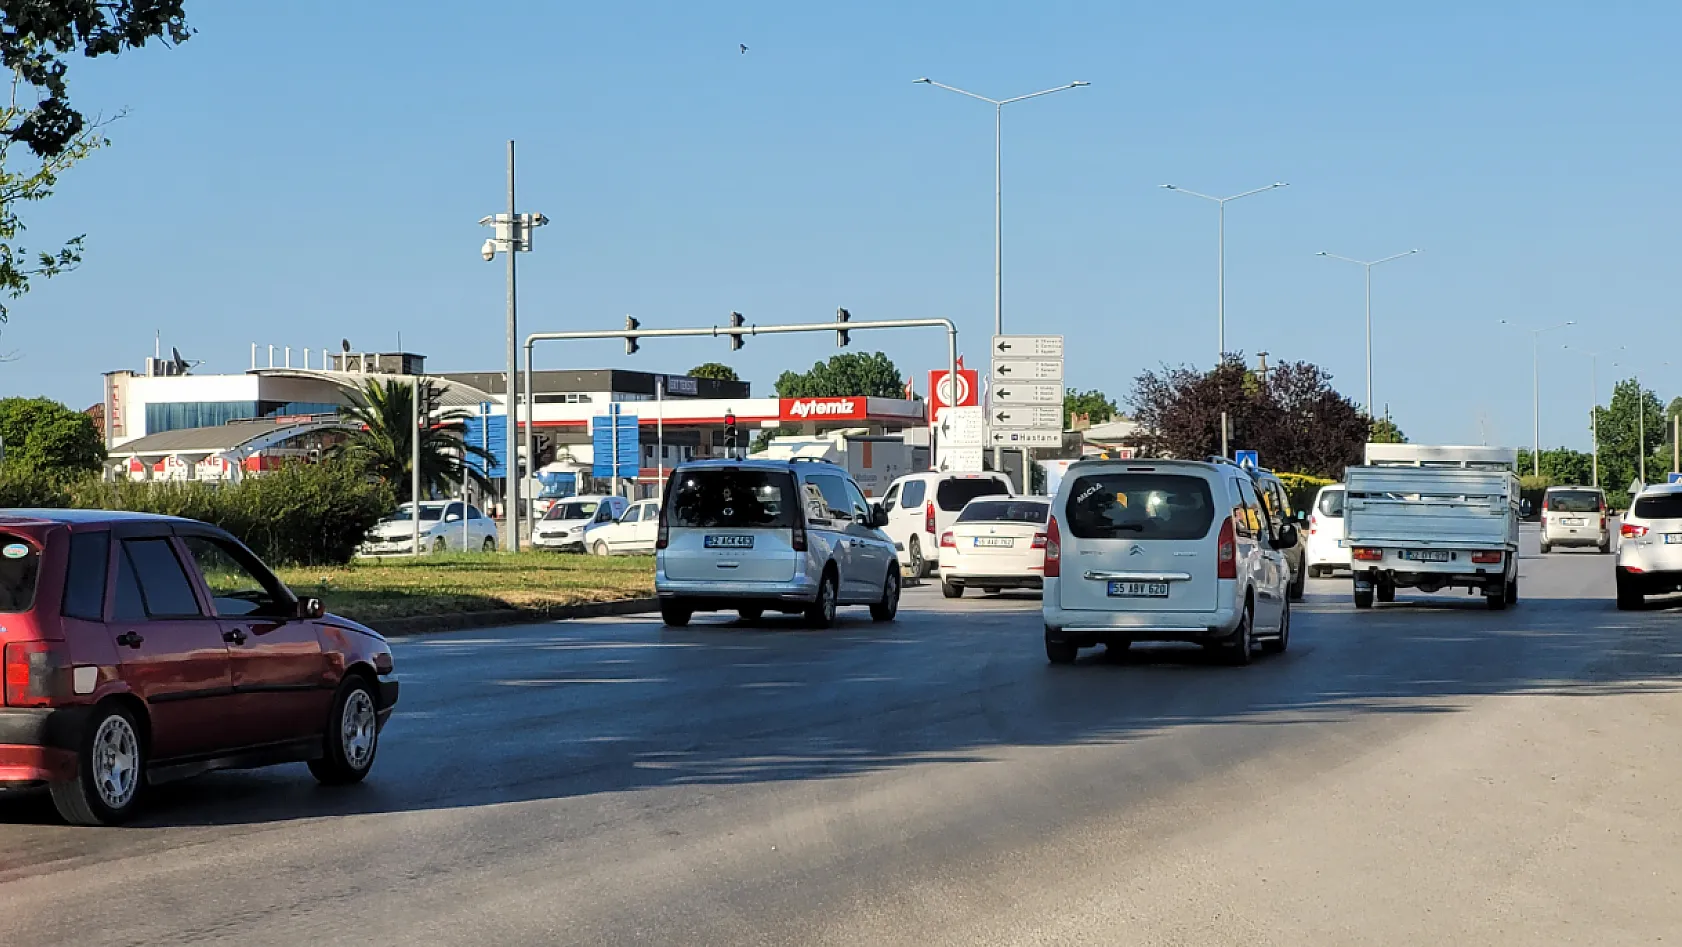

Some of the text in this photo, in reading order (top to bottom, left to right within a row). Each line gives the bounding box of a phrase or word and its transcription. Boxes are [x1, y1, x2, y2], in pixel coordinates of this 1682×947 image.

[790, 399, 855, 417] Aytemiz
[1020, 433, 1058, 442] Hastane
[1113, 583, 1165, 594] 55 ABV 620
